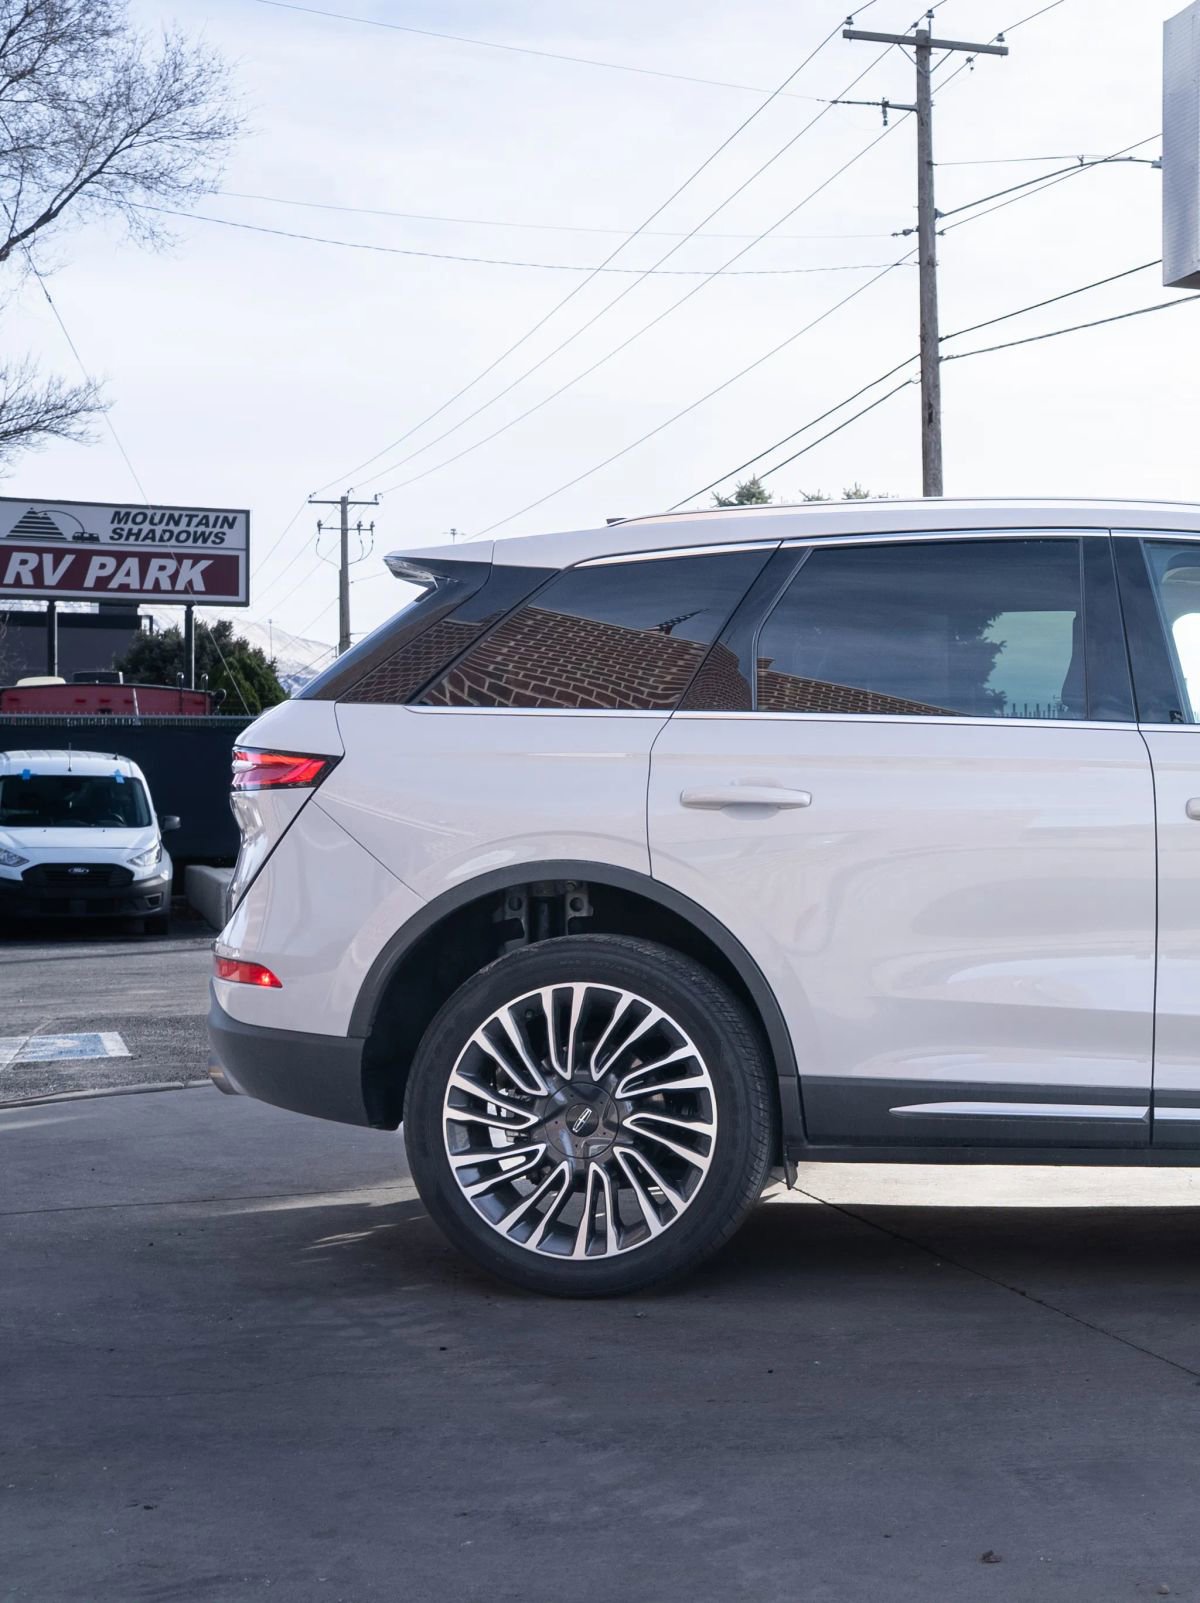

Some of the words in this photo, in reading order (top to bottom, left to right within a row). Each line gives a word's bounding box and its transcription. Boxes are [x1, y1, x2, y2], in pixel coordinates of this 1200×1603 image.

[111, 510, 238, 530] MOUNTAIN
[109, 527, 227, 546] SHADOWS
[2, 552, 76, 586] RV
[84, 556, 214, 592] PARK
